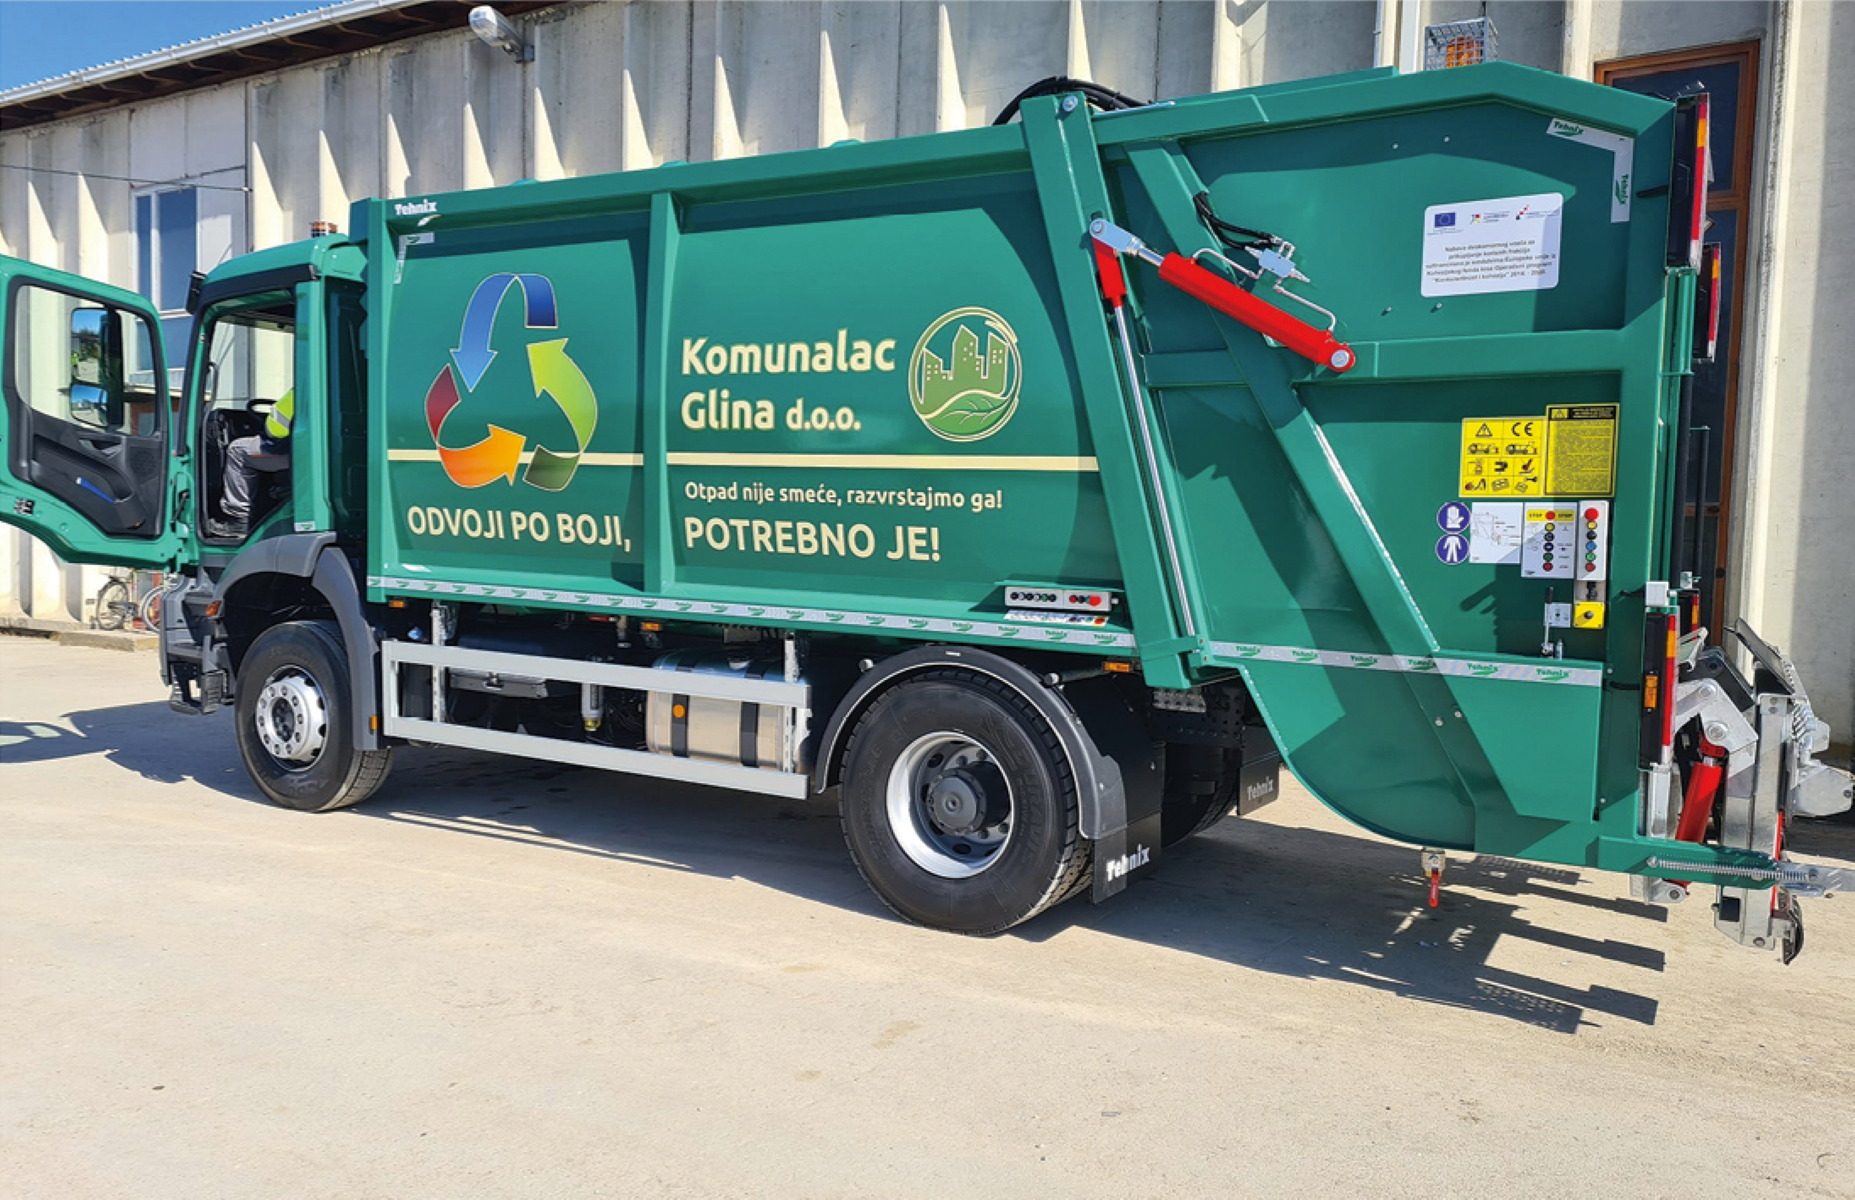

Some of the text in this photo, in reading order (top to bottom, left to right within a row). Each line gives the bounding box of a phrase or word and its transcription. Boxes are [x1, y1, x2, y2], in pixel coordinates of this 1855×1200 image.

[681, 327, 897, 375] Komunalac
[681, 388, 862, 431] Glina d.o.o.
[684, 481, 1002, 513] Otpad nije smeće, razvrstajmo ga!
[407, 505, 631, 552] ODVOJI PO BOJI,
[684, 516, 941, 562] POTREBNO JE!
